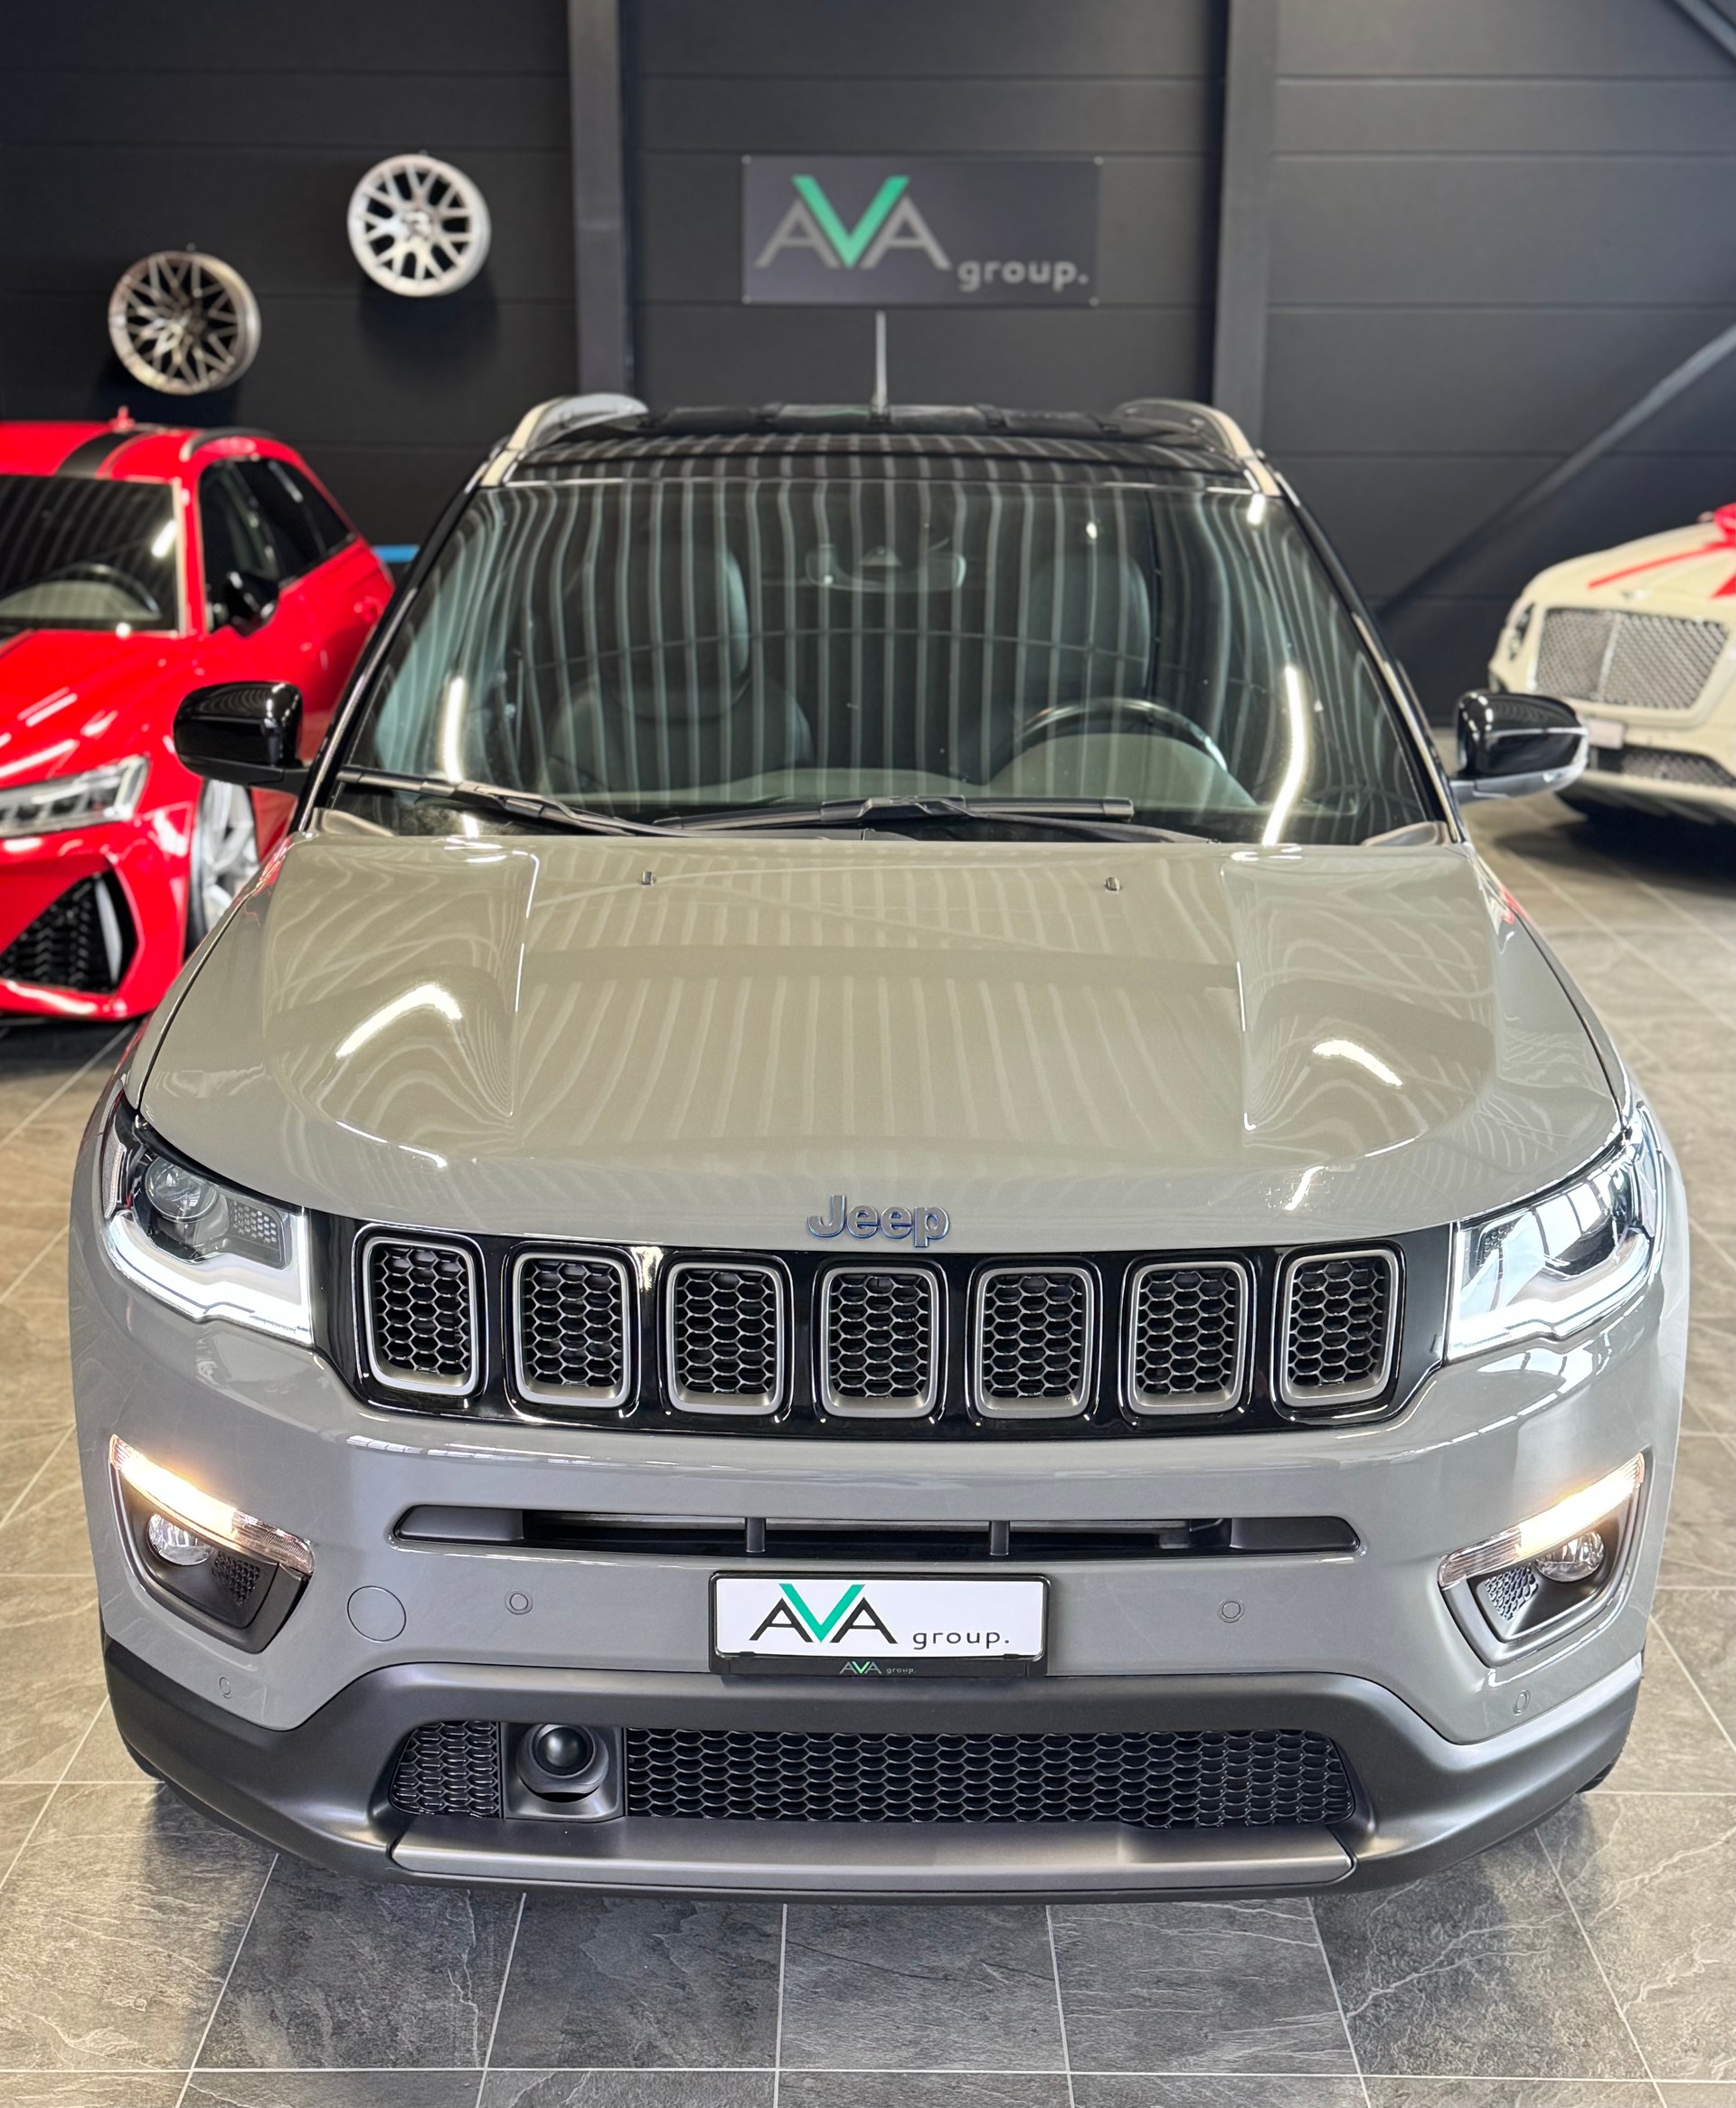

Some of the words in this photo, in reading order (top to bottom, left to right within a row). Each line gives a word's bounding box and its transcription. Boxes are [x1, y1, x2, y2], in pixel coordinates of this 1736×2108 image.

[755, 175, 952, 269] AVA
[957, 260, 1089, 292] group.
[807, 1195, 949, 1248] Jeep
[749, 1583, 898, 1644] AVA
[912, 1631, 1010, 1650] group.
